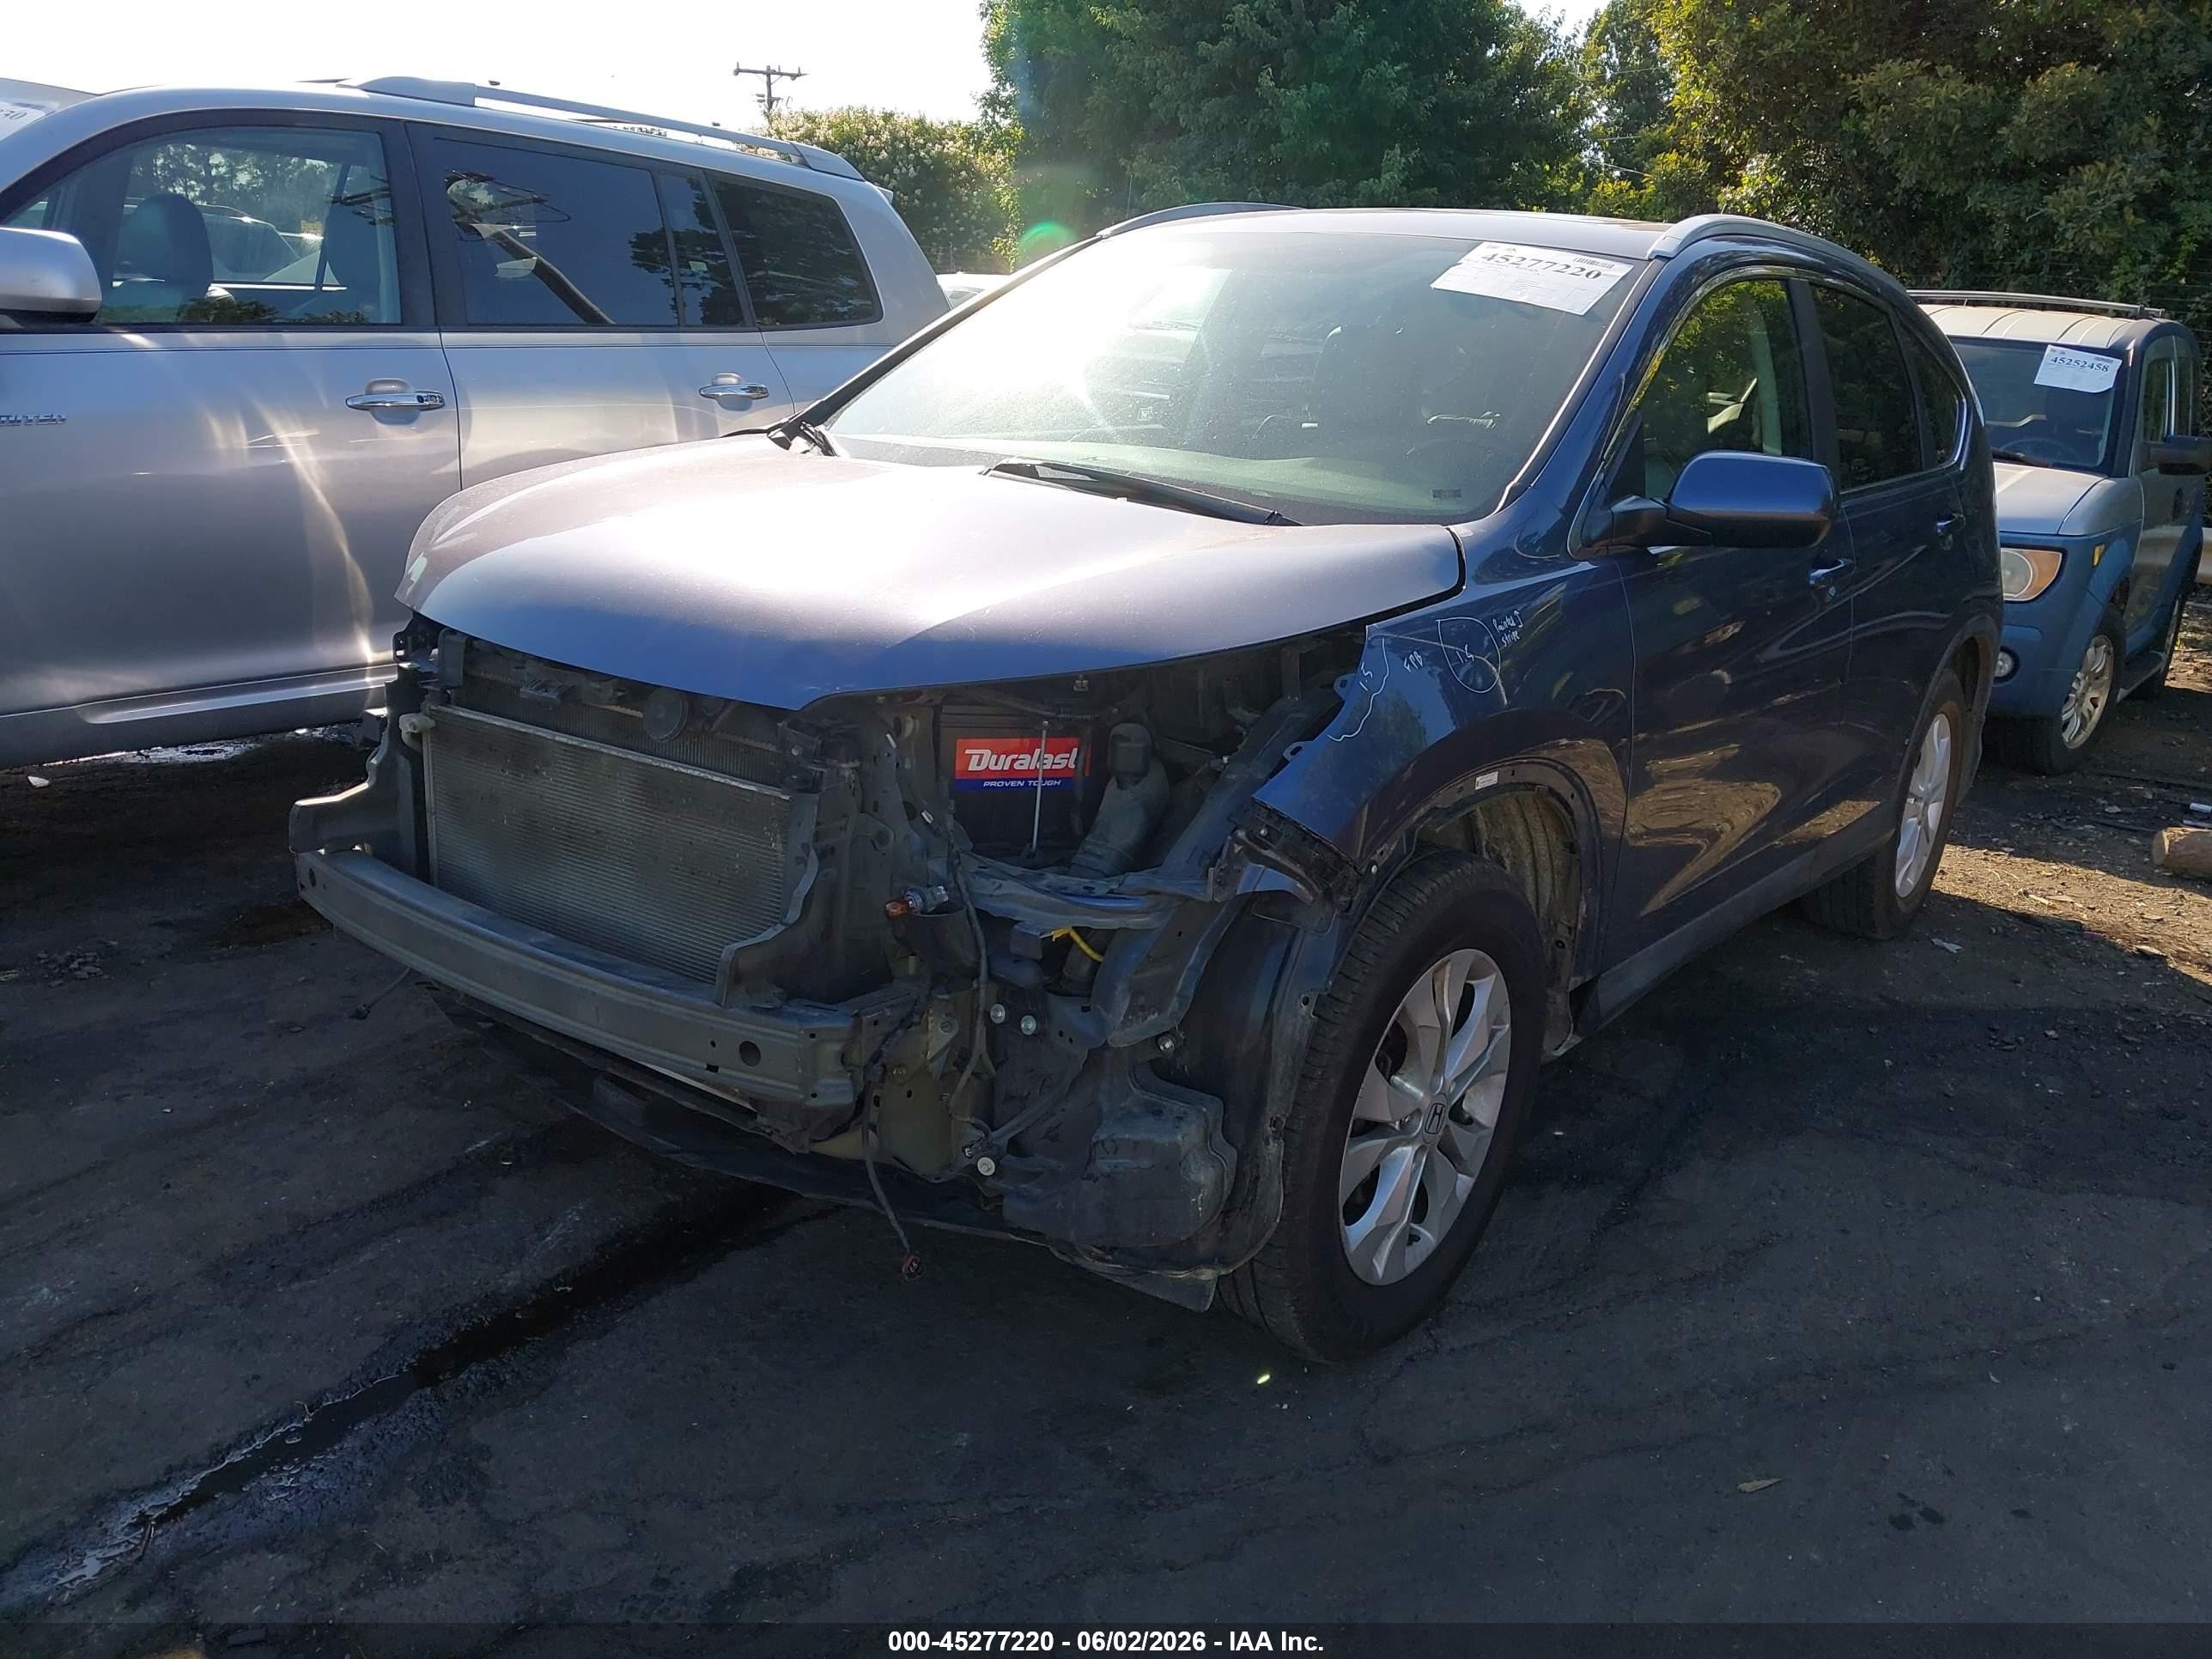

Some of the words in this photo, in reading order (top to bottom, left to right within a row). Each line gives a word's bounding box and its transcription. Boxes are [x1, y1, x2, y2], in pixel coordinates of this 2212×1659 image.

[1481, 253, 1602, 280] 45277220
[2051, 356, 2110, 372] 45252458
[964, 747, 1079, 771] Duralast
